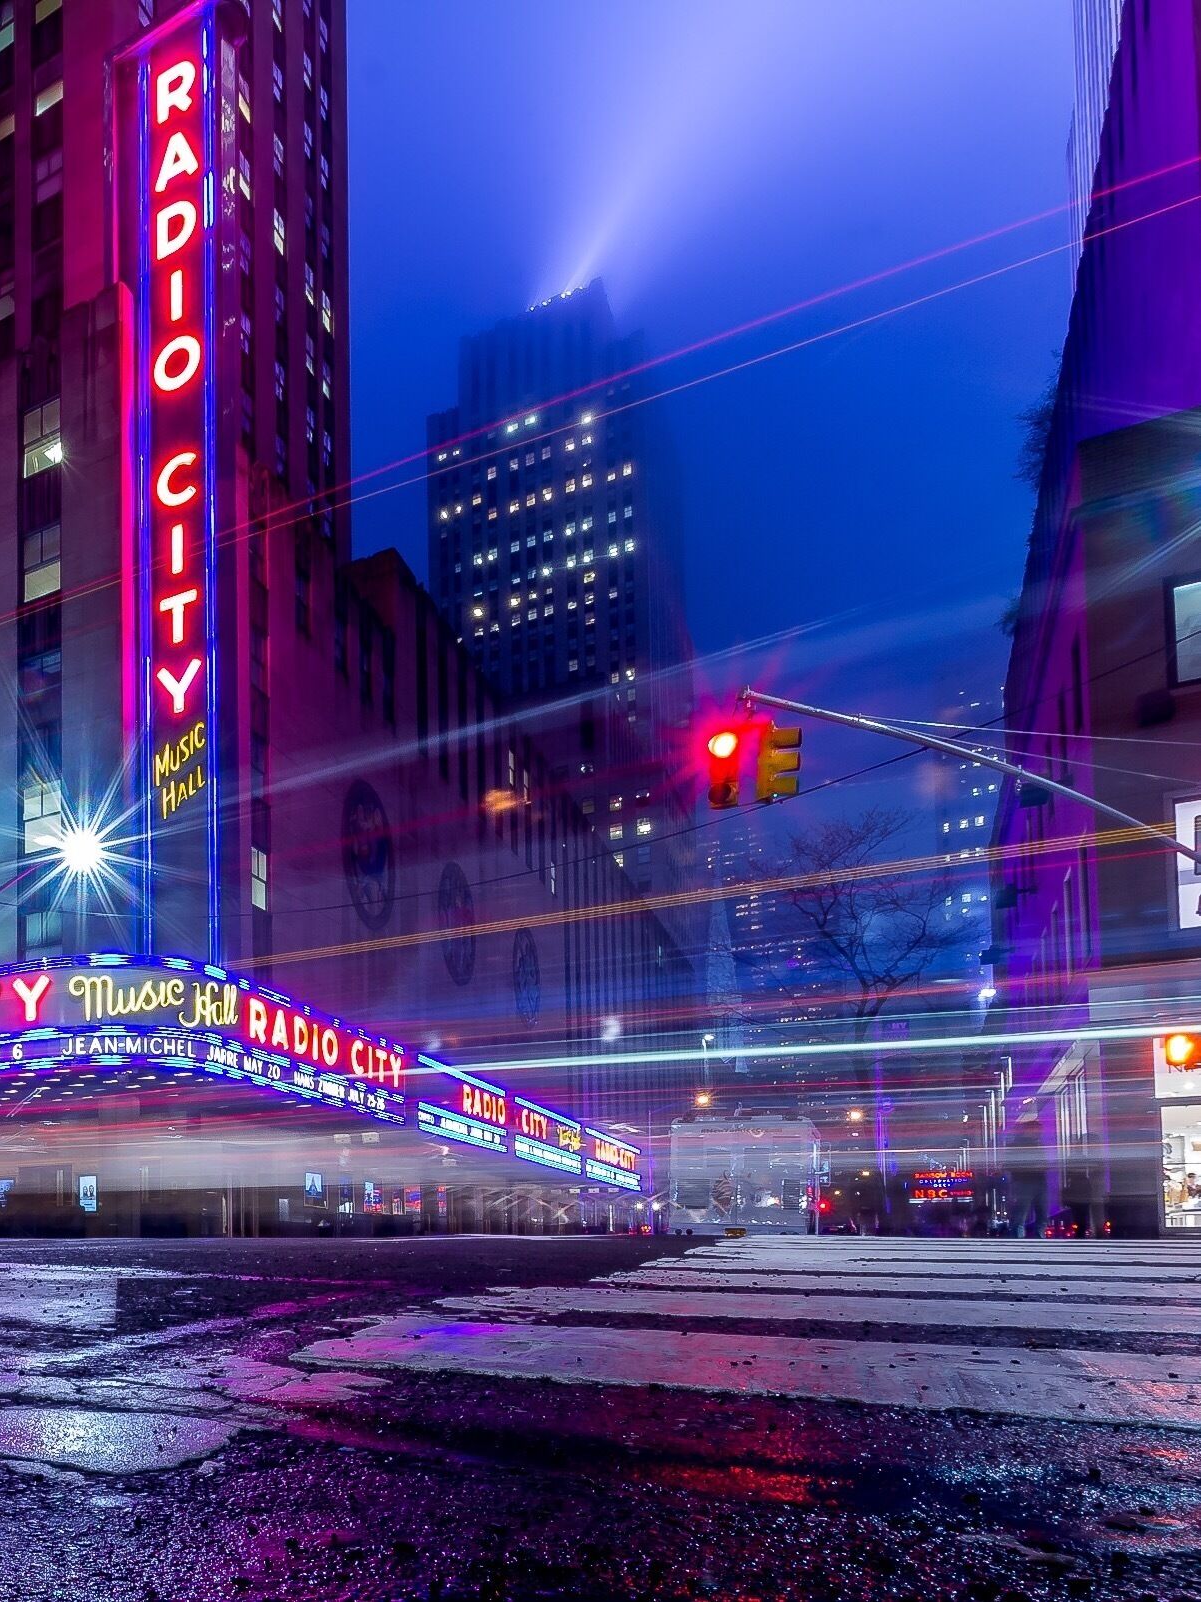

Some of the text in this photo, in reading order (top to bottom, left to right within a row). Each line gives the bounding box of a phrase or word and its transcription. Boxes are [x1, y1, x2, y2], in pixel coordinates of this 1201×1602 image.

[154, 61, 202, 713] RADIO CITY
[12, 1043, 23, 1060] 6
[62, 1037, 196, 1058] JEAN-MICHEL
[207, 1045, 238, 1068] JARRE
[243, 1056, 263, 1076] MAY
[267, 1062, 281, 1080] 20
[68, 975, 401, 1087] Music Hall RADIO CITY
[462, 1083, 506, 1125] RADIO
[521, 1108, 548, 1140] CITY
